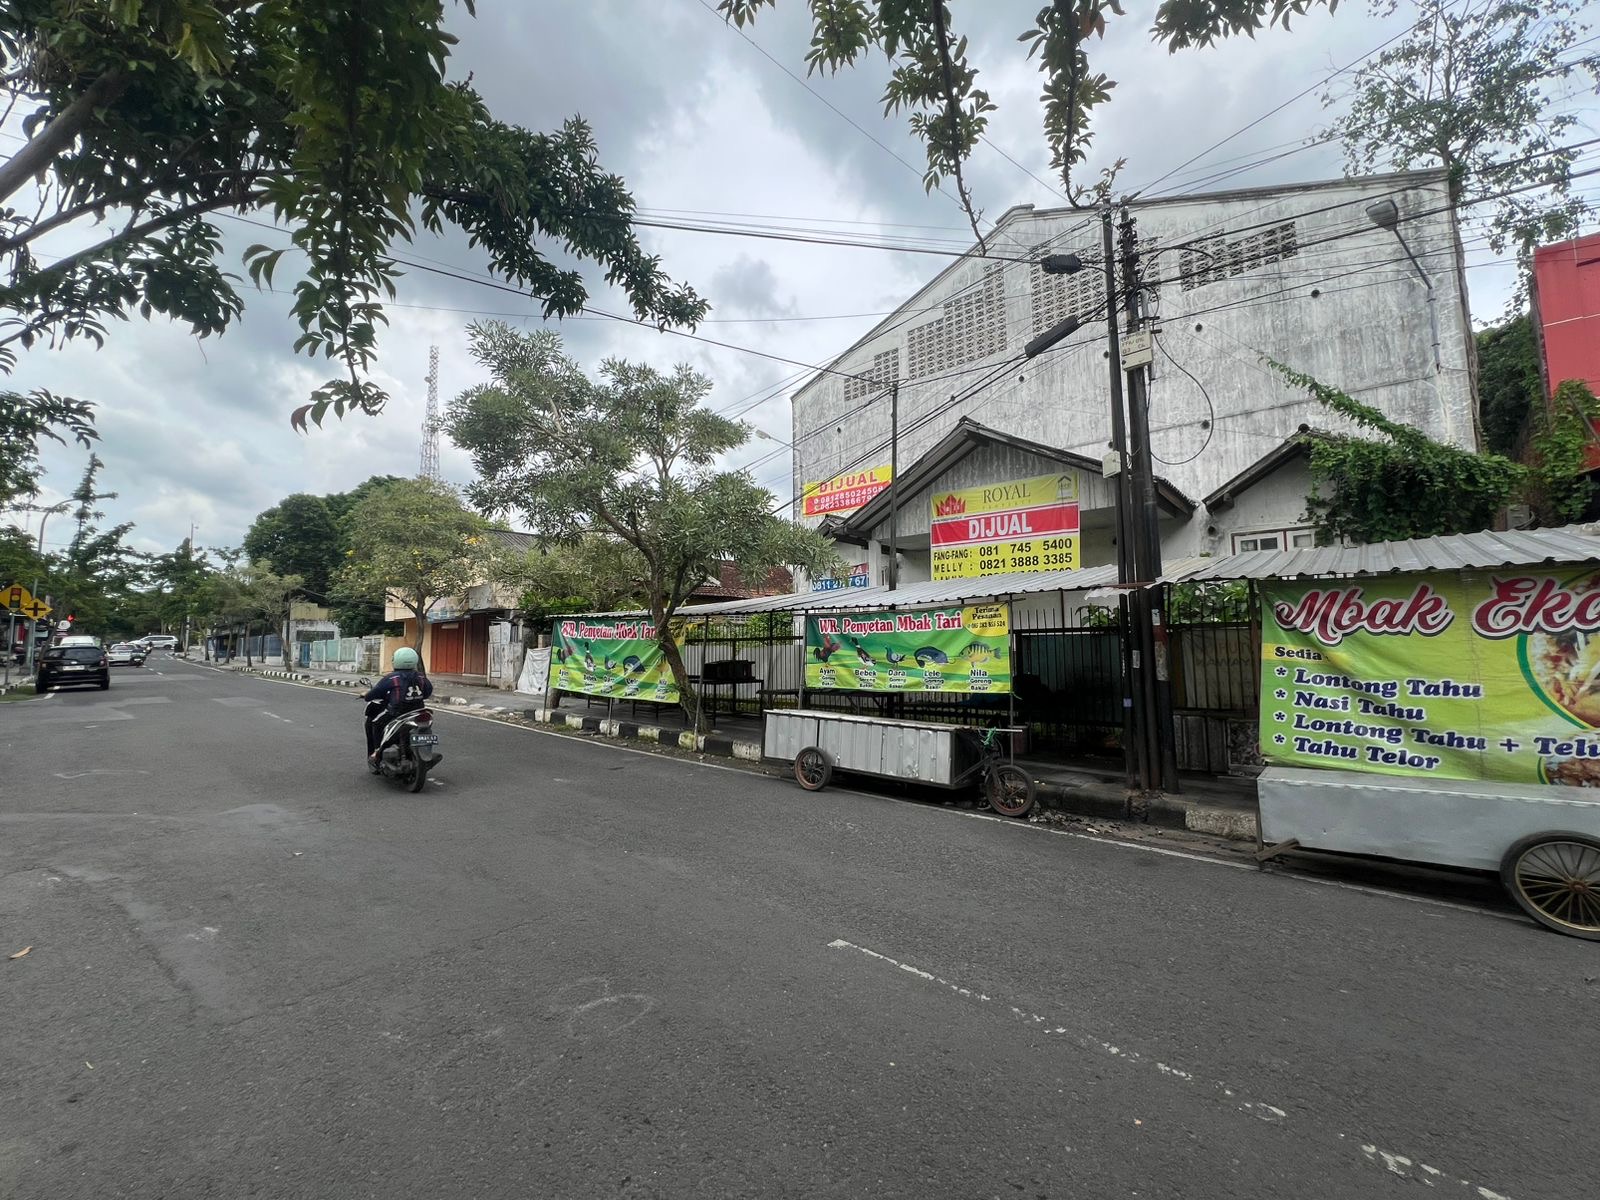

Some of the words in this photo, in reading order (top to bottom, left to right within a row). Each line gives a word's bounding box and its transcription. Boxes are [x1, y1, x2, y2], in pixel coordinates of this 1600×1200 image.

[821, 472, 878, 492] DIJUAL
[983, 483, 1031, 503] ROYAL
[968, 513, 1032, 539] DIJUAL
[979, 545, 999, 557] 081
[1010, 542, 1032, 554] 745
[1043, 538, 1073, 550] 5400
[934, 562, 963, 573] MELLY
[979, 559, 1006, 570] 0821
[1011, 556, 1039, 568] 3888
[1043, 553, 1073, 565] 3385
[819, 619, 841, 633] WR.
[843, 618, 894, 636] Penyetan
[897, 615, 932, 632] Mbak
[935, 612, 962, 629] Tari
[1273, 582, 1452, 646] Mbak
[641, 622, 657, 639] Tar
[820, 668, 836, 676] Ayam
[855, 669, 877, 677] Bebek
[888, 669, 906, 677] Dara
[970, 669, 988, 677] Nila
[1294, 668, 1398, 698] Lontong
[1406, 678, 1482, 698] Tahu
[1293, 691, 1350, 711] Nasi
[1357, 698, 1425, 721] Tahu
[1293, 713, 1403, 744] Lontong
[1410, 728, 1487, 750] Tahu
[1293, 736, 1357, 760] Tahu
[1365, 745, 1440, 769] Telor
